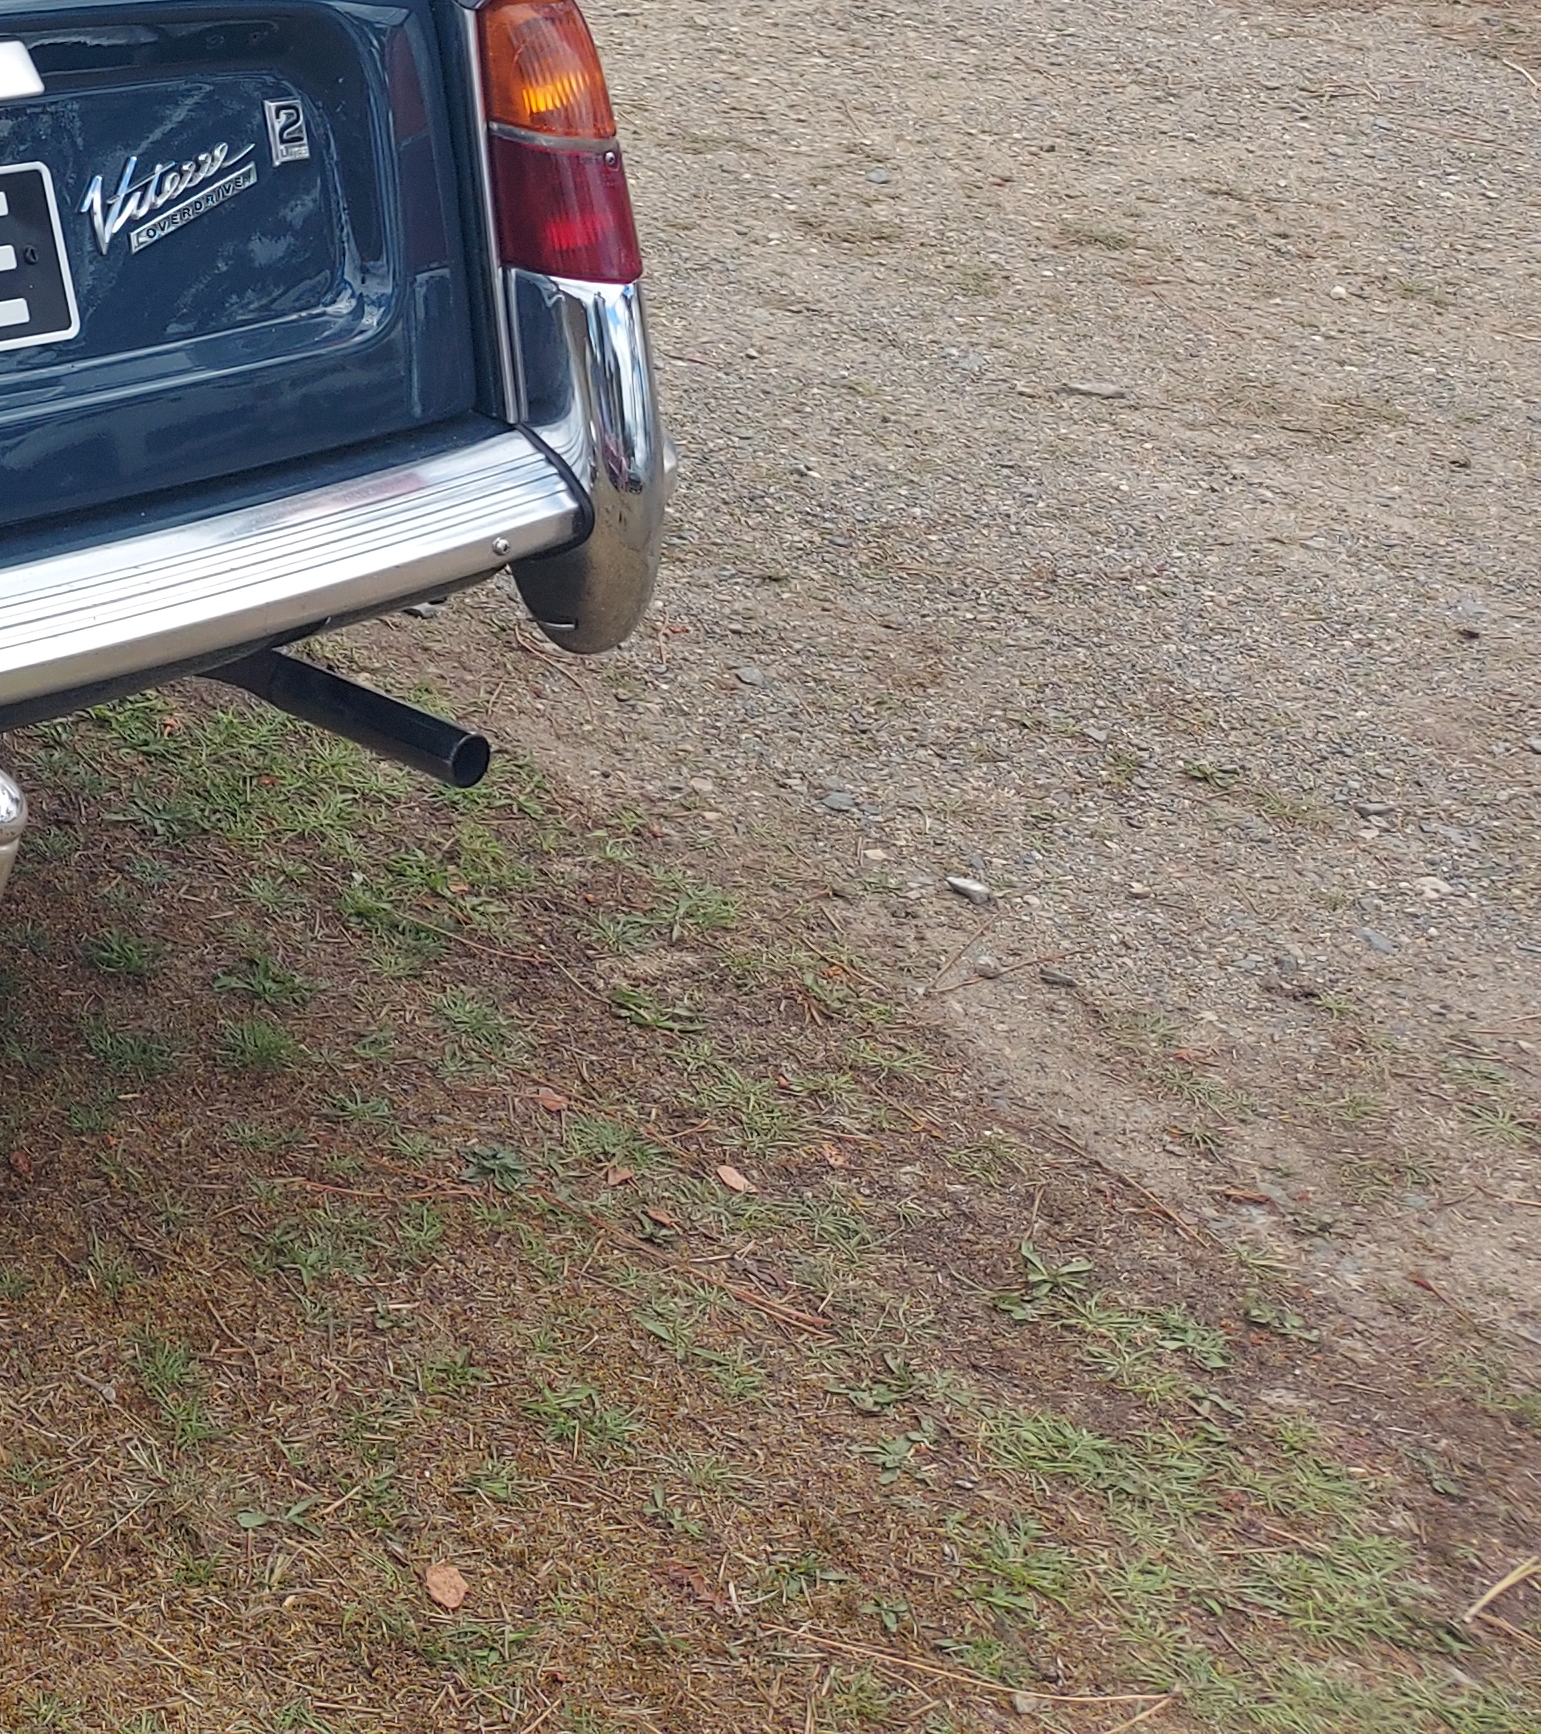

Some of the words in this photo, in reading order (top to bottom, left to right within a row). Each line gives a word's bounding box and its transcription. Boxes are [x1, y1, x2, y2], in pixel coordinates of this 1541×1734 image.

[274, 104, 305, 145] 2
[77, 142, 256, 256] Vitesse
[146, 176, 244, 240] OVERDRIVE
